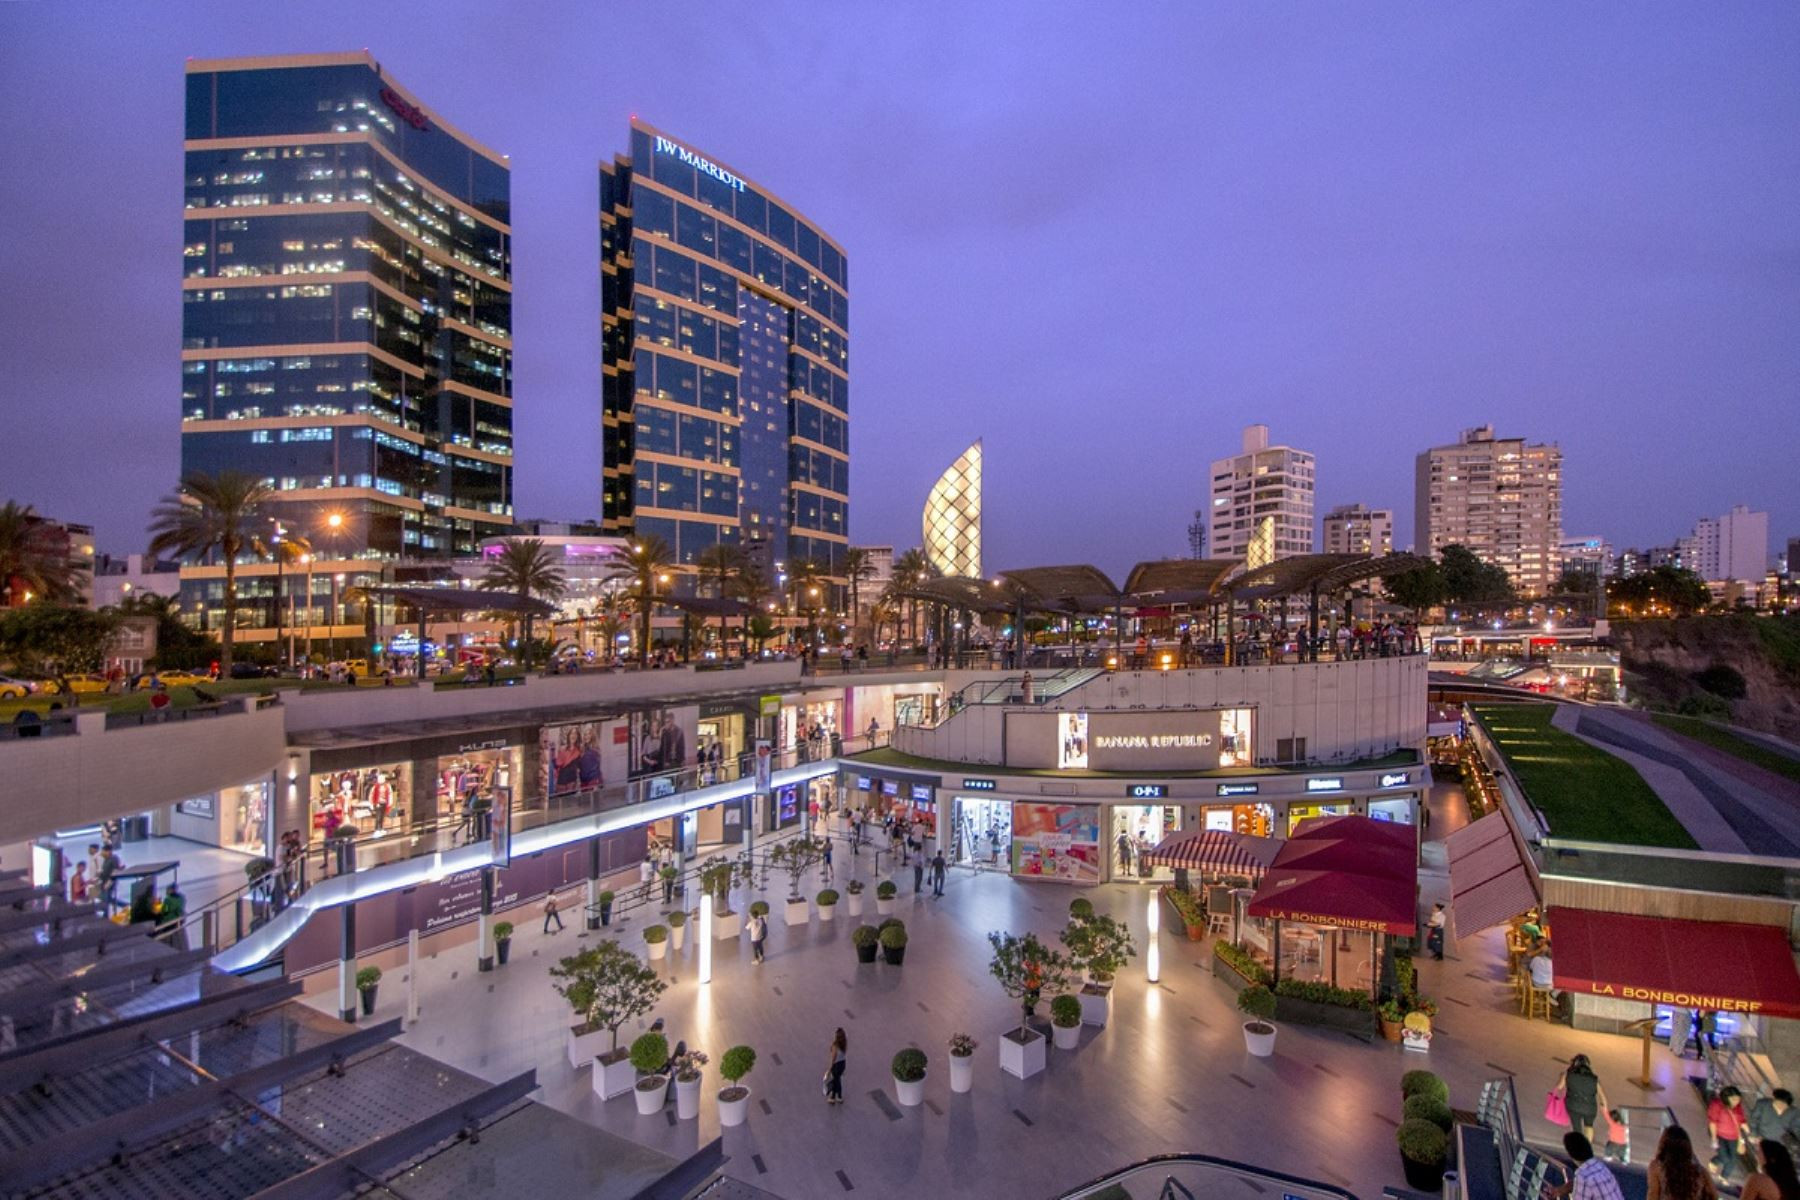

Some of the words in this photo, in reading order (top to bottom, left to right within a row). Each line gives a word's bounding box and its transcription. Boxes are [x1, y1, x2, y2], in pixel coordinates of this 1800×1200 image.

[656, 135, 678, 156] JW
[679, 147, 748, 193] MARRIOTT
[1096, 736, 1149, 748] BANANA
[1151, 735, 1211, 748] REPUBLIC
[1270, 909, 1286, 919] LA
[1291, 912, 1388, 932] BONBONNIERE
[1592, 983, 1615, 995] LA
[1623, 987, 1763, 1012] BONBONNIERE
